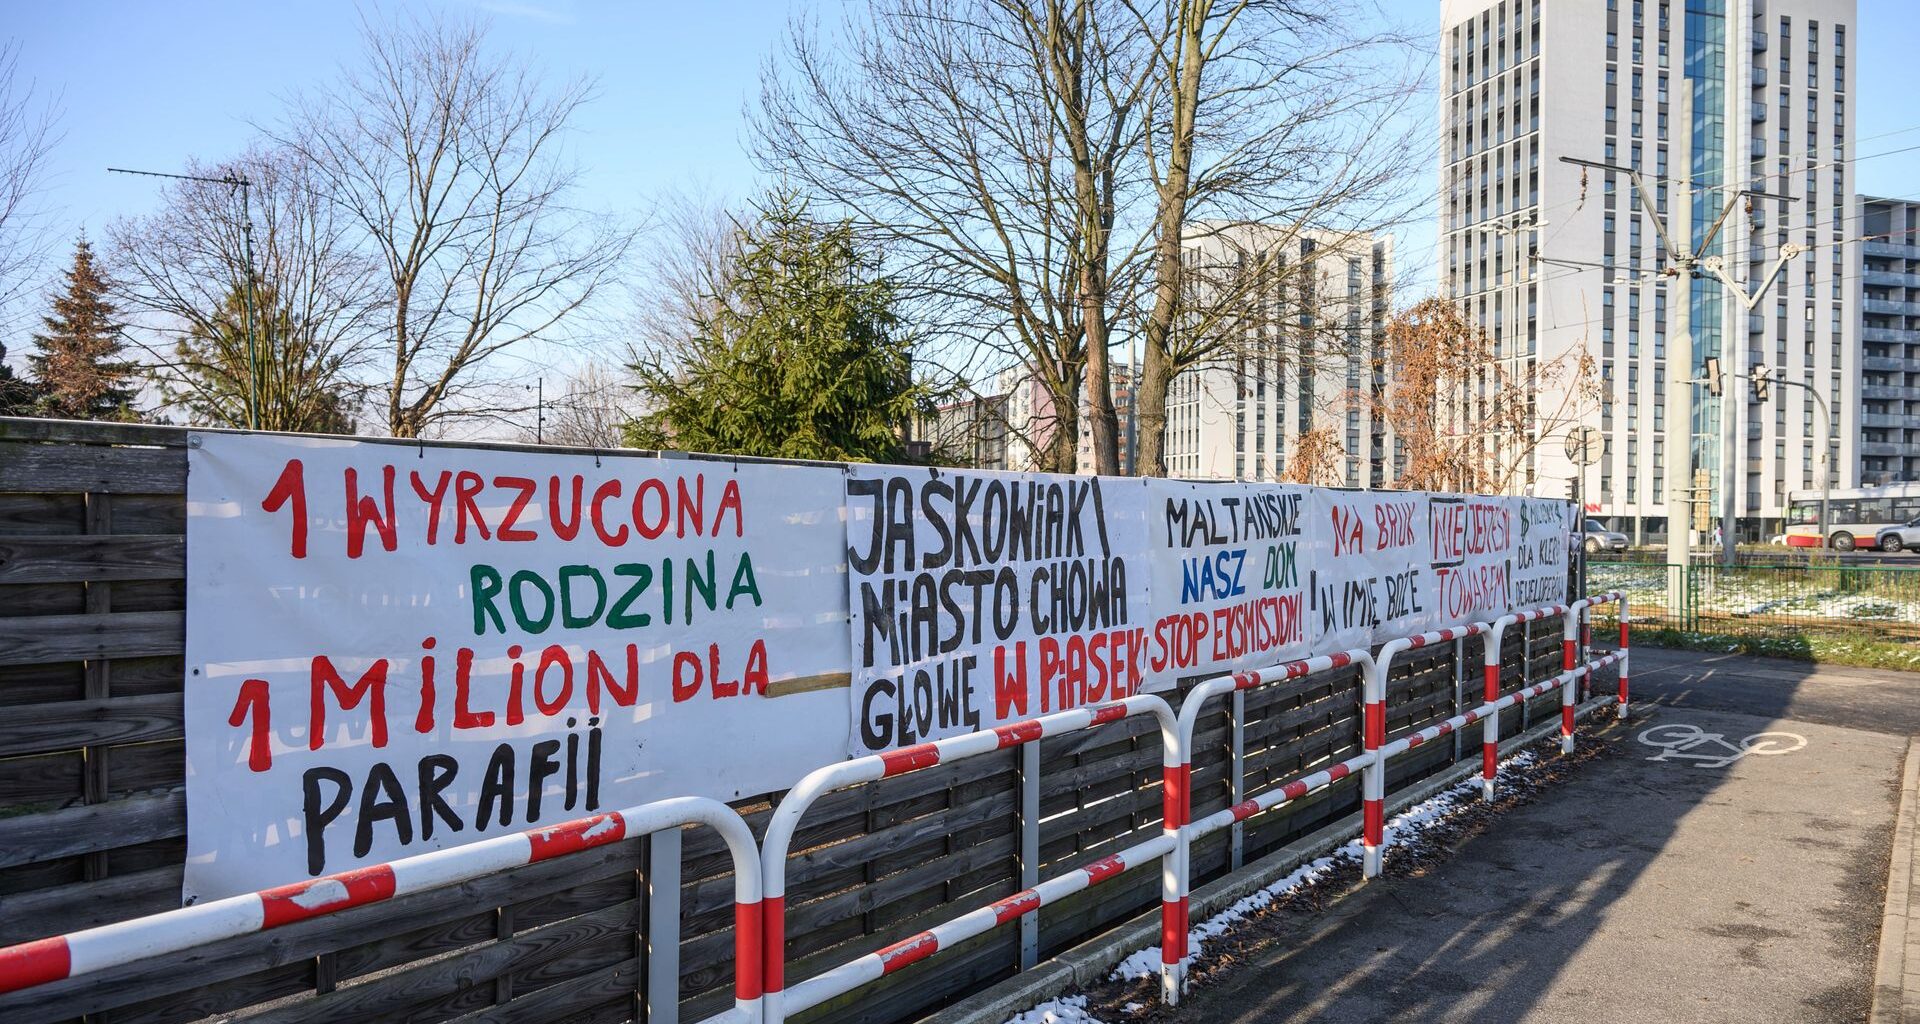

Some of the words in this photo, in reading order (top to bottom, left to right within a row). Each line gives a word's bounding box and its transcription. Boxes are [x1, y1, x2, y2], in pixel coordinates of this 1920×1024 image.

[262, 459, 308, 559] 1
[345, 464, 743, 560] WYRZUCONA
[1166, 493, 1302, 548] MALTAŃSKIE
[1332, 505, 1364, 557] NA
[1375, 502, 1416, 550] BRUK
[1434, 505, 1464, 560] NIE
[471, 550, 761, 635] RODZINA
[1030, 556, 1127, 635] CHOWA
[1182, 549, 1247, 604] NASZ
[1264, 541, 1297, 590] DOM
[1322, 584, 1337, 634] W
[1343, 577, 1380, 629] IMIĘ
[1437, 559, 1513, 624] TOWAREM!
[1150, 611, 1209, 673] STOP
[1212, 590, 1304, 660] EKSMISJOM!
[229, 679, 271, 772] 1
[673, 639, 769, 703] DLA
[860, 656, 980, 750] GŁOWĘ
[994, 641, 1028, 720] W
